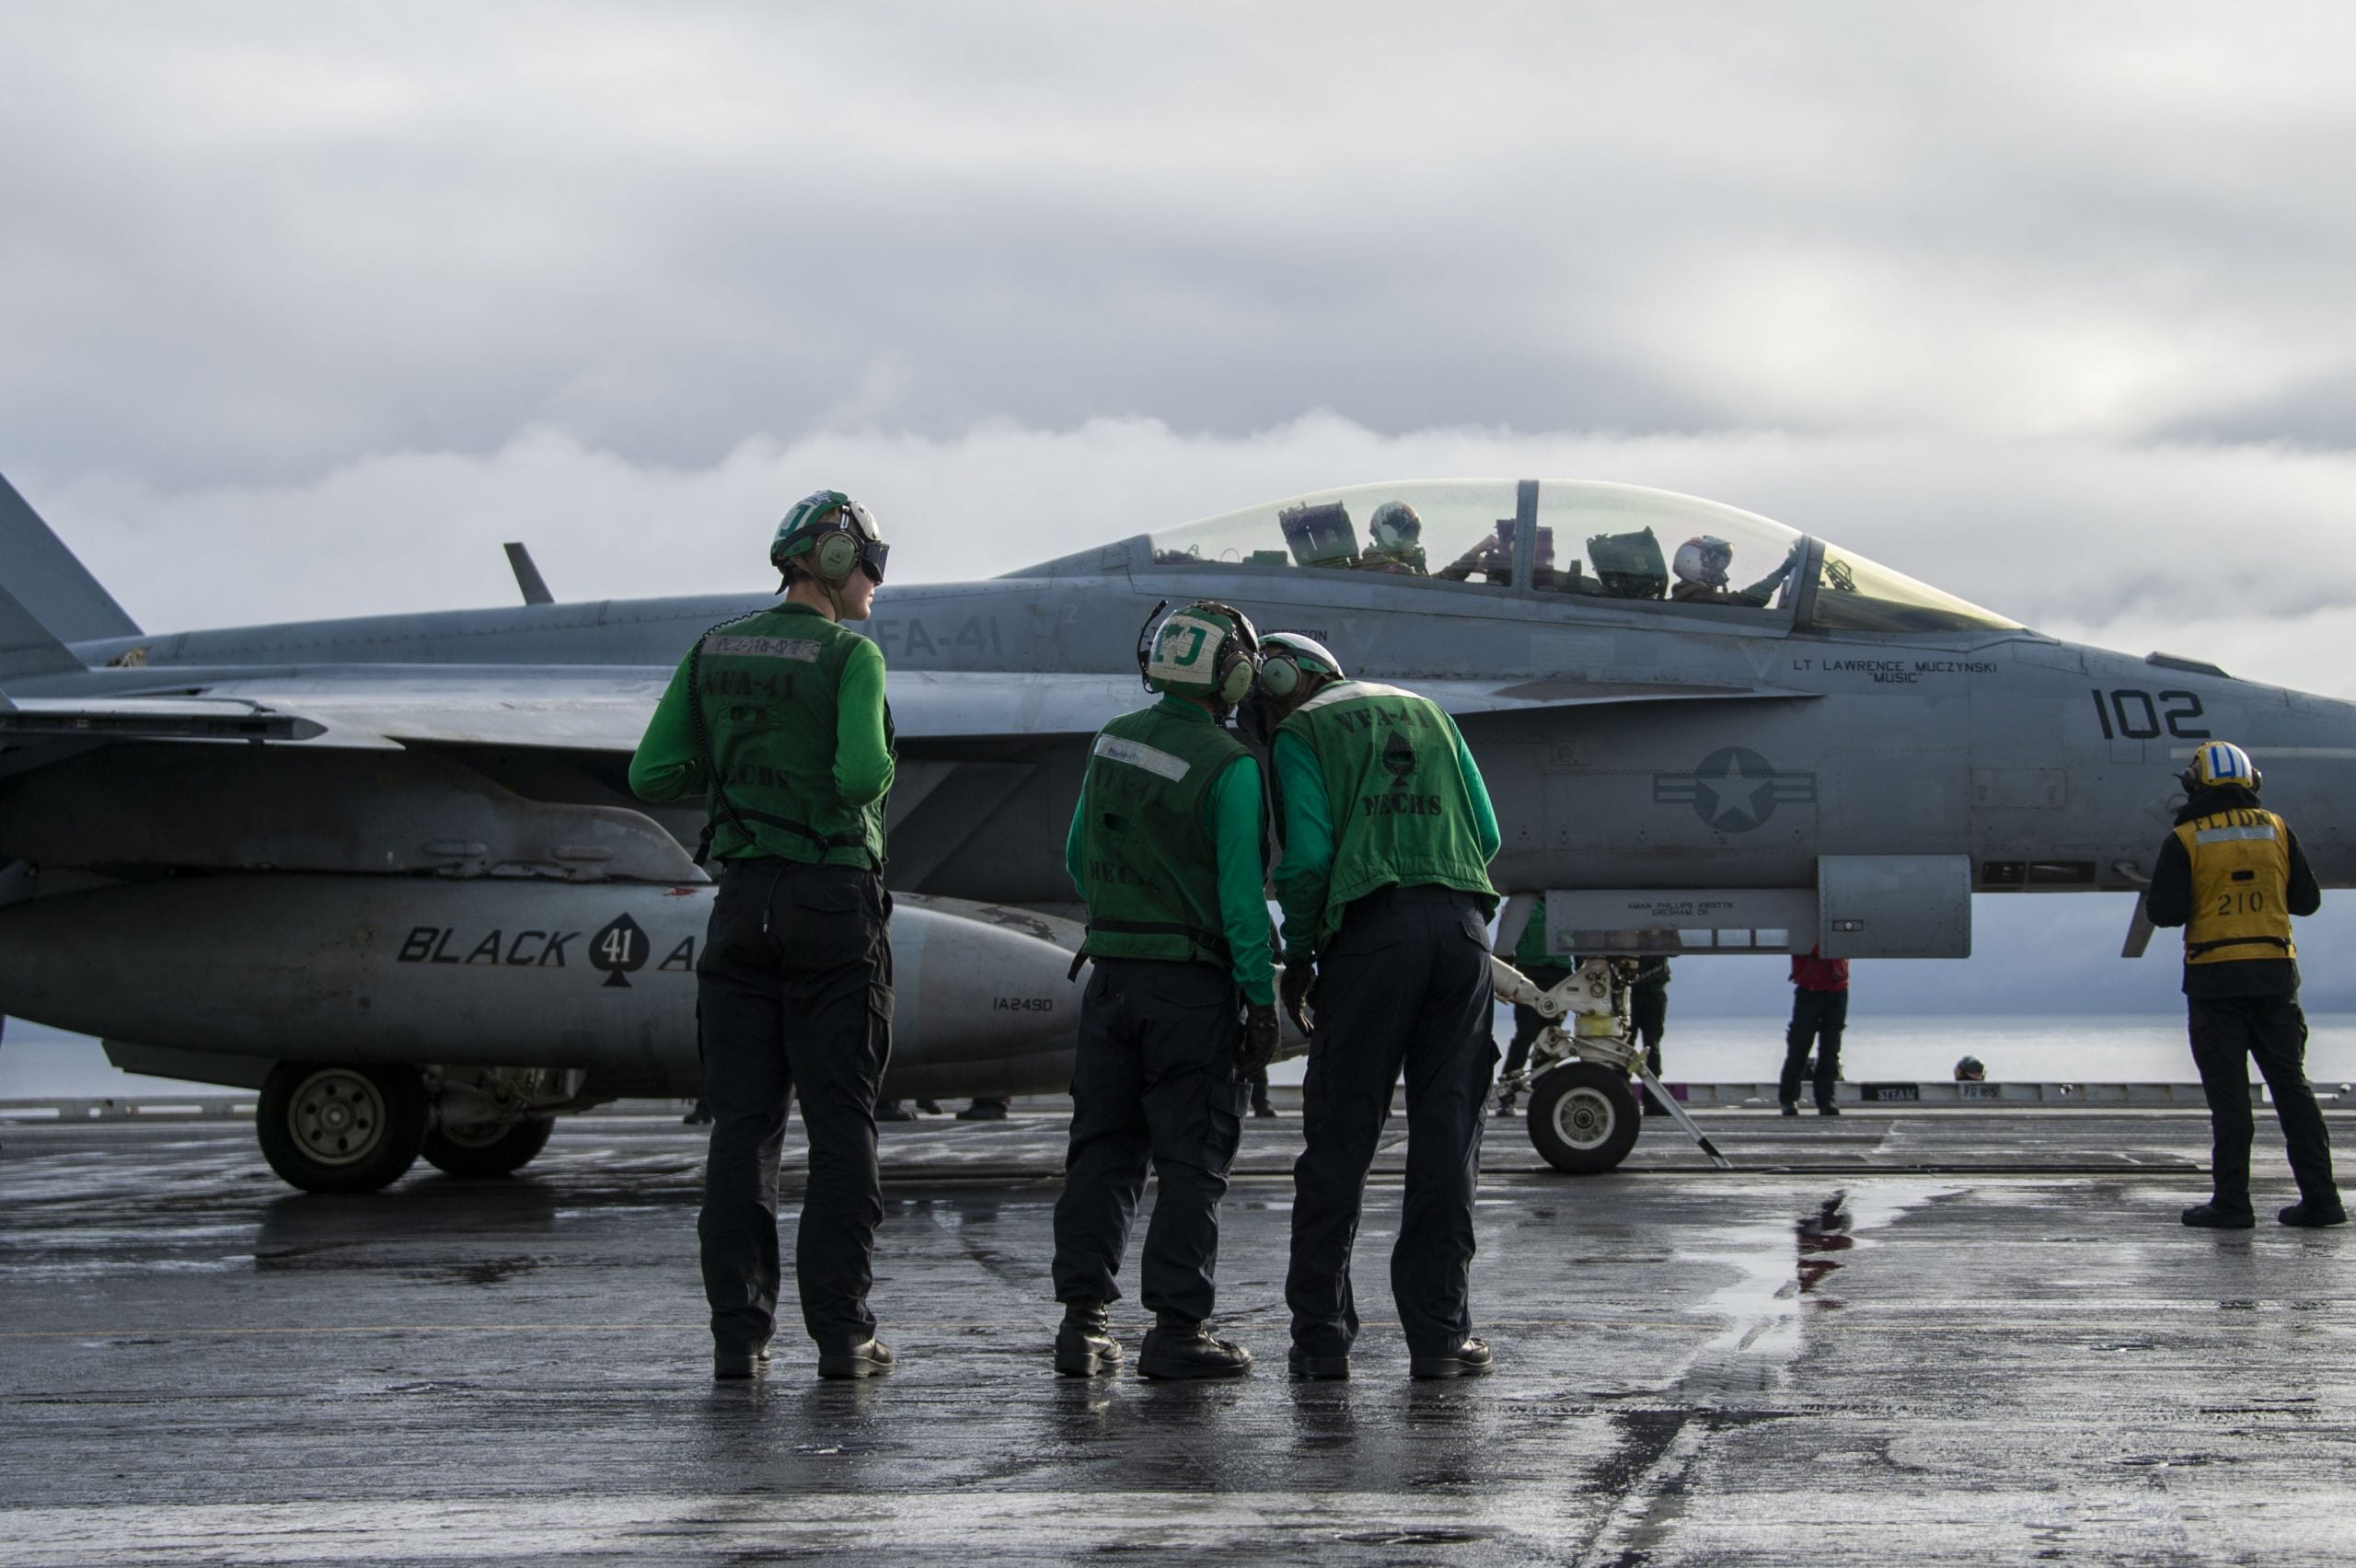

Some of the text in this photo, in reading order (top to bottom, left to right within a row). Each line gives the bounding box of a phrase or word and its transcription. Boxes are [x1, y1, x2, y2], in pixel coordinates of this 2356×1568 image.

[1794, 659, 1998, 674] LT LAWRENCE MUCZYNSKI
[1334, 706, 1429, 733] VFA-41
[2091, 688, 2212, 740] 102
[2217, 890, 2264, 917] 210
[397, 926, 583, 967] BLACK
[601, 928, 633, 963] 41
[1877, 1088, 1916, 1101] STEAM
